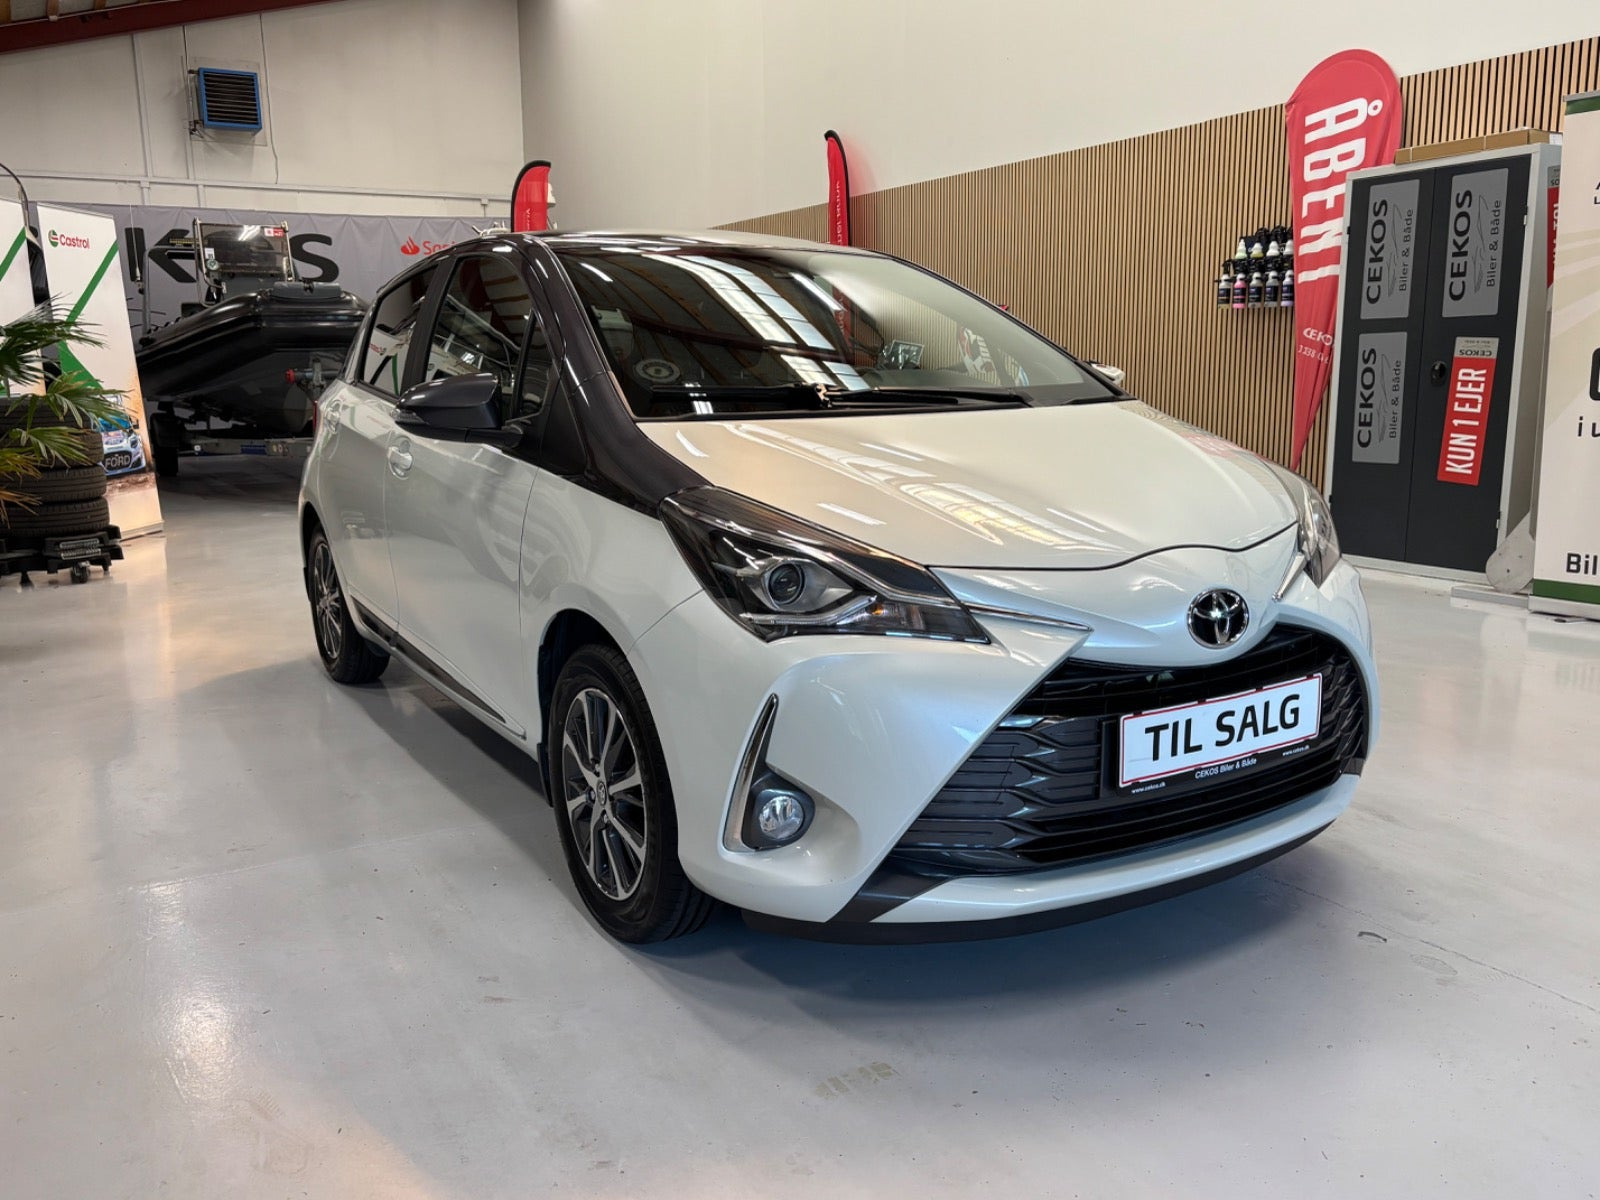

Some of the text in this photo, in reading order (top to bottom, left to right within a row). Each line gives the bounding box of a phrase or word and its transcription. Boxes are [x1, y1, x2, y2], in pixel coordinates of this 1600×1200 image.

[59, 233, 90, 249] Castrol
[1366, 199, 1388, 304] CEKOS
[1399, 209, 1414, 291] Biler & Både
[1448, 189, 1473, 301] CEKOS
[1486, 200, 1501, 287] Biler & Både
[1357, 348, 1377, 448] CEKOS
[1388, 360, 1402, 439] Biler & Både
[1452, 419, 1480, 427] 1
[1453, 368, 1487, 413] EJER
[105, 454, 131, 468] FORD
[1445, 433, 1477, 475] KUN
[1144, 693, 1300, 762] TIL SALG
[1194, 766, 1219, 780] CEKOS
[1219, 763, 1235, 773] Biler
